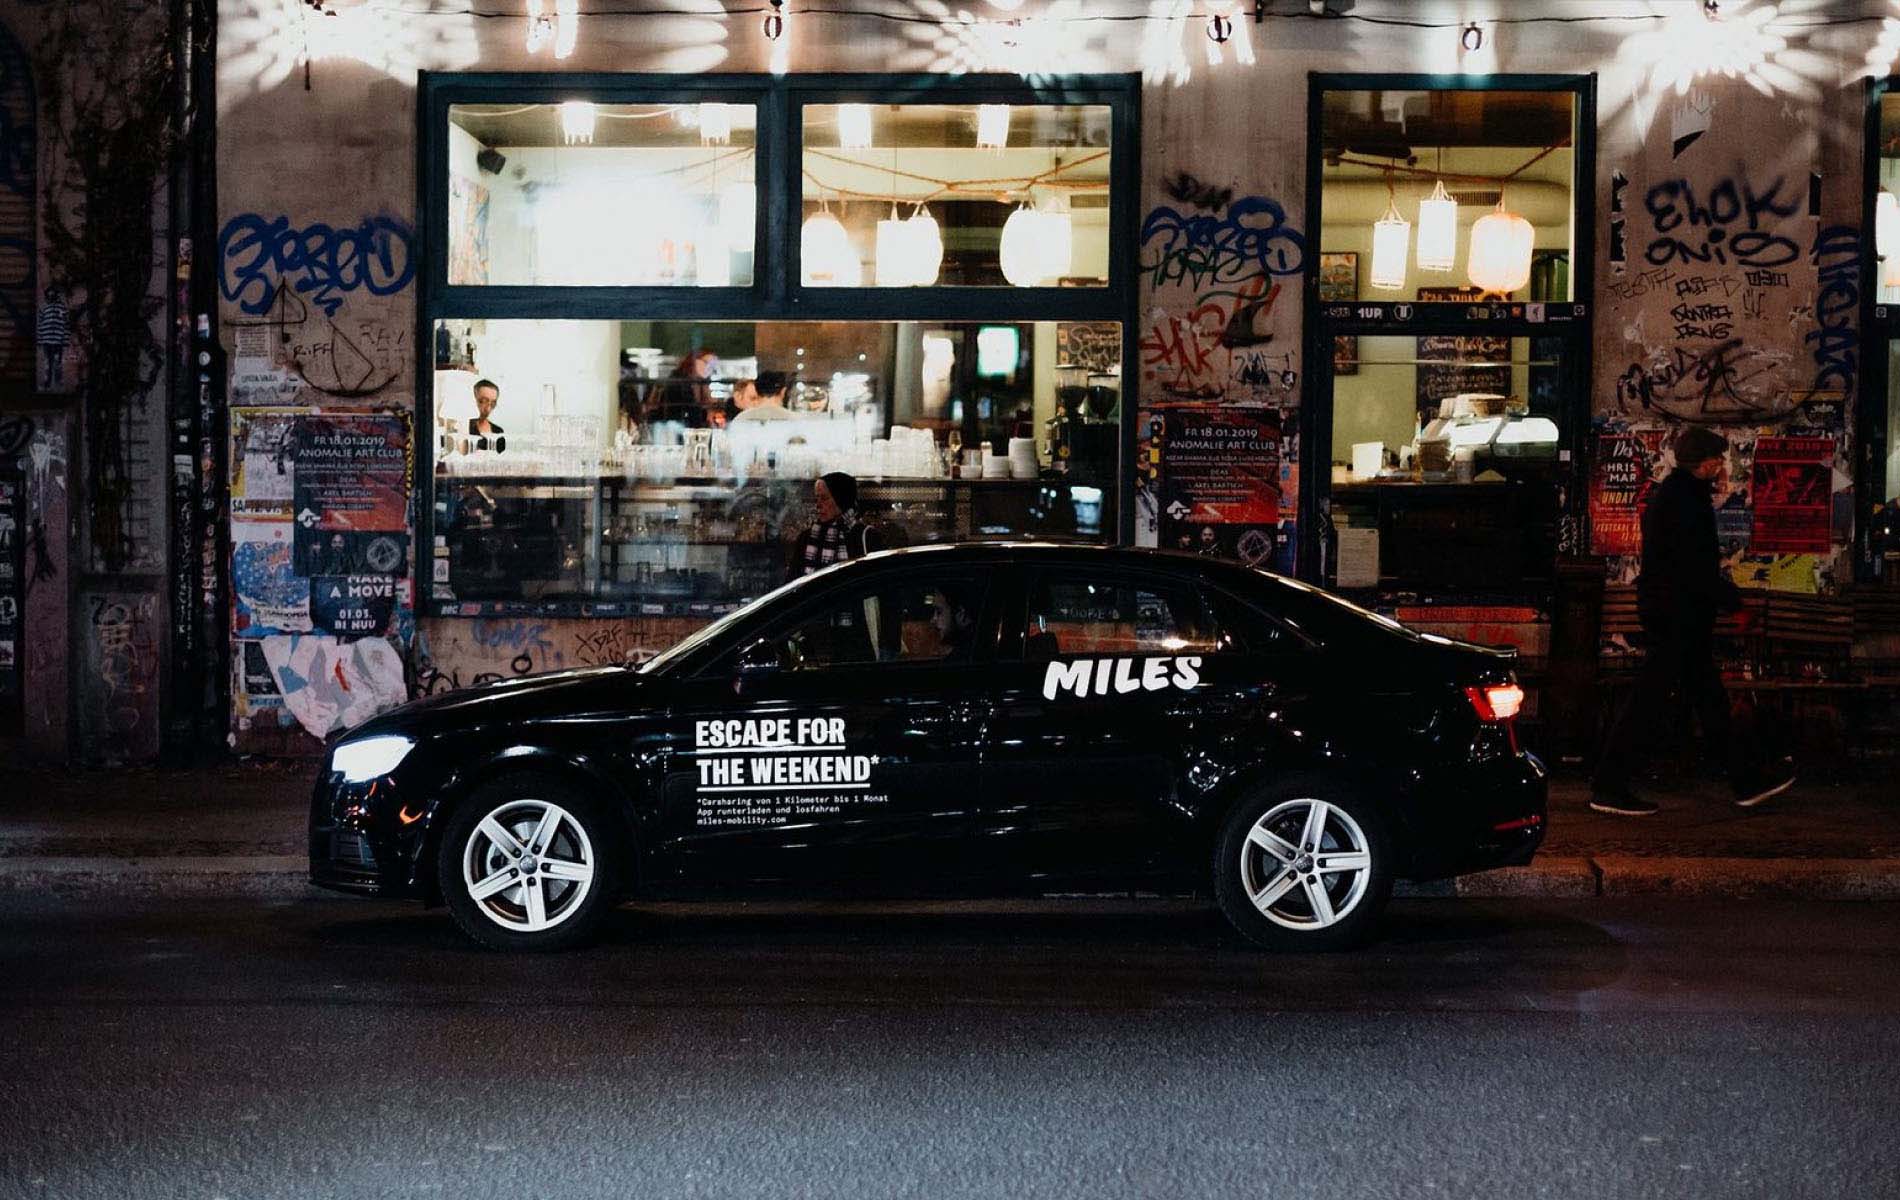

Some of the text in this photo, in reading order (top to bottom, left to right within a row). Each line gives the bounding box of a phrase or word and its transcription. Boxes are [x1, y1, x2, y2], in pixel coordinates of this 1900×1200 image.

[1185, 426, 1258, 439] FR 18.01.2019
[314, 434, 385, 446] FR 18.01.2019
[1169, 440, 1276, 449] ANOMALIE ART CLUB
[298, 448, 402, 457] ANOMALIE ART CLUB
[330, 585, 393, 598] A MOVE
[1042, 656, 1203, 701] MILES
[695, 717, 846, 747] ESCAPE FOR
[696, 758, 745, 785] THE
[756, 797, 771, 805] von
[785, 796, 830, 804] Kilometer
[834, 795, 849, 803] bis
[863, 795, 889, 803] Monat
[697, 808, 713, 817] App
[775, 806, 791, 814] und
